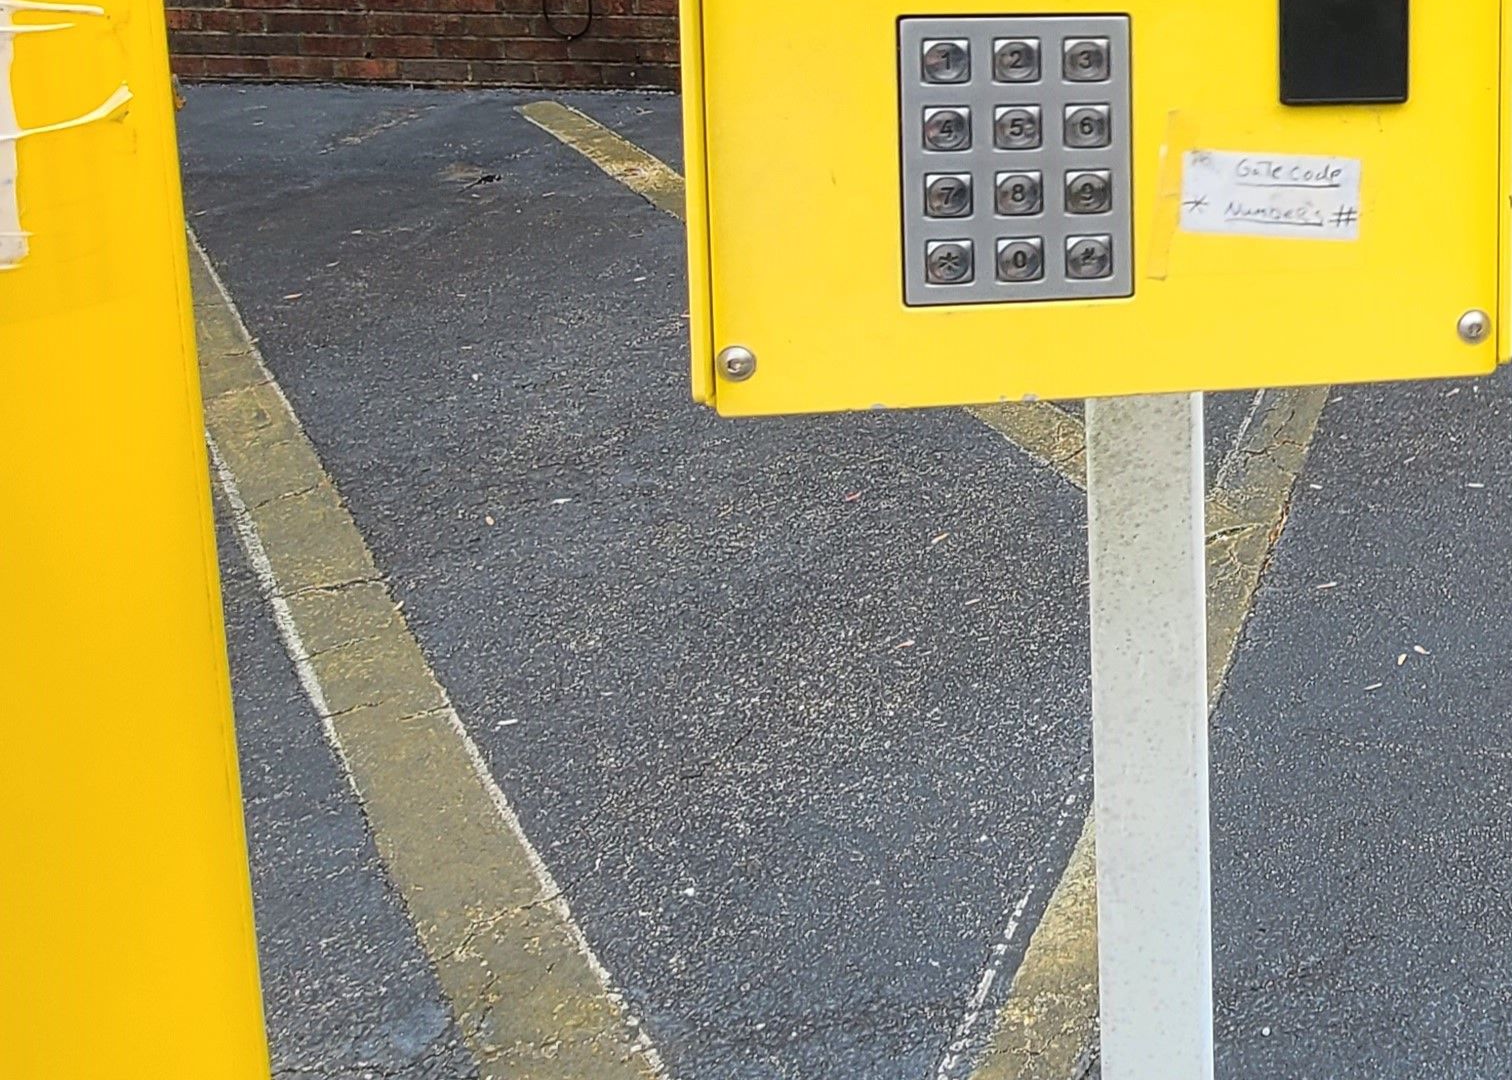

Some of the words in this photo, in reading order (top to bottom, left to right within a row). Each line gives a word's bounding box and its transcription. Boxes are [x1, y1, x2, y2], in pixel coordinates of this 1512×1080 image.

[940, 50, 952, 70] 1
[1008, 49, 1024, 69] 2
[1077, 49, 1092, 69] 3
[939, 119, 954, 139] 4
[1009, 118, 1024, 137] 5
[1079, 115, 1094, 136] 6
[940, 185, 957, 206] 7
[1011, 182, 1025, 203] 8
[1080, 181, 1095, 202] 9
[1013, 249, 1028, 269] 0
